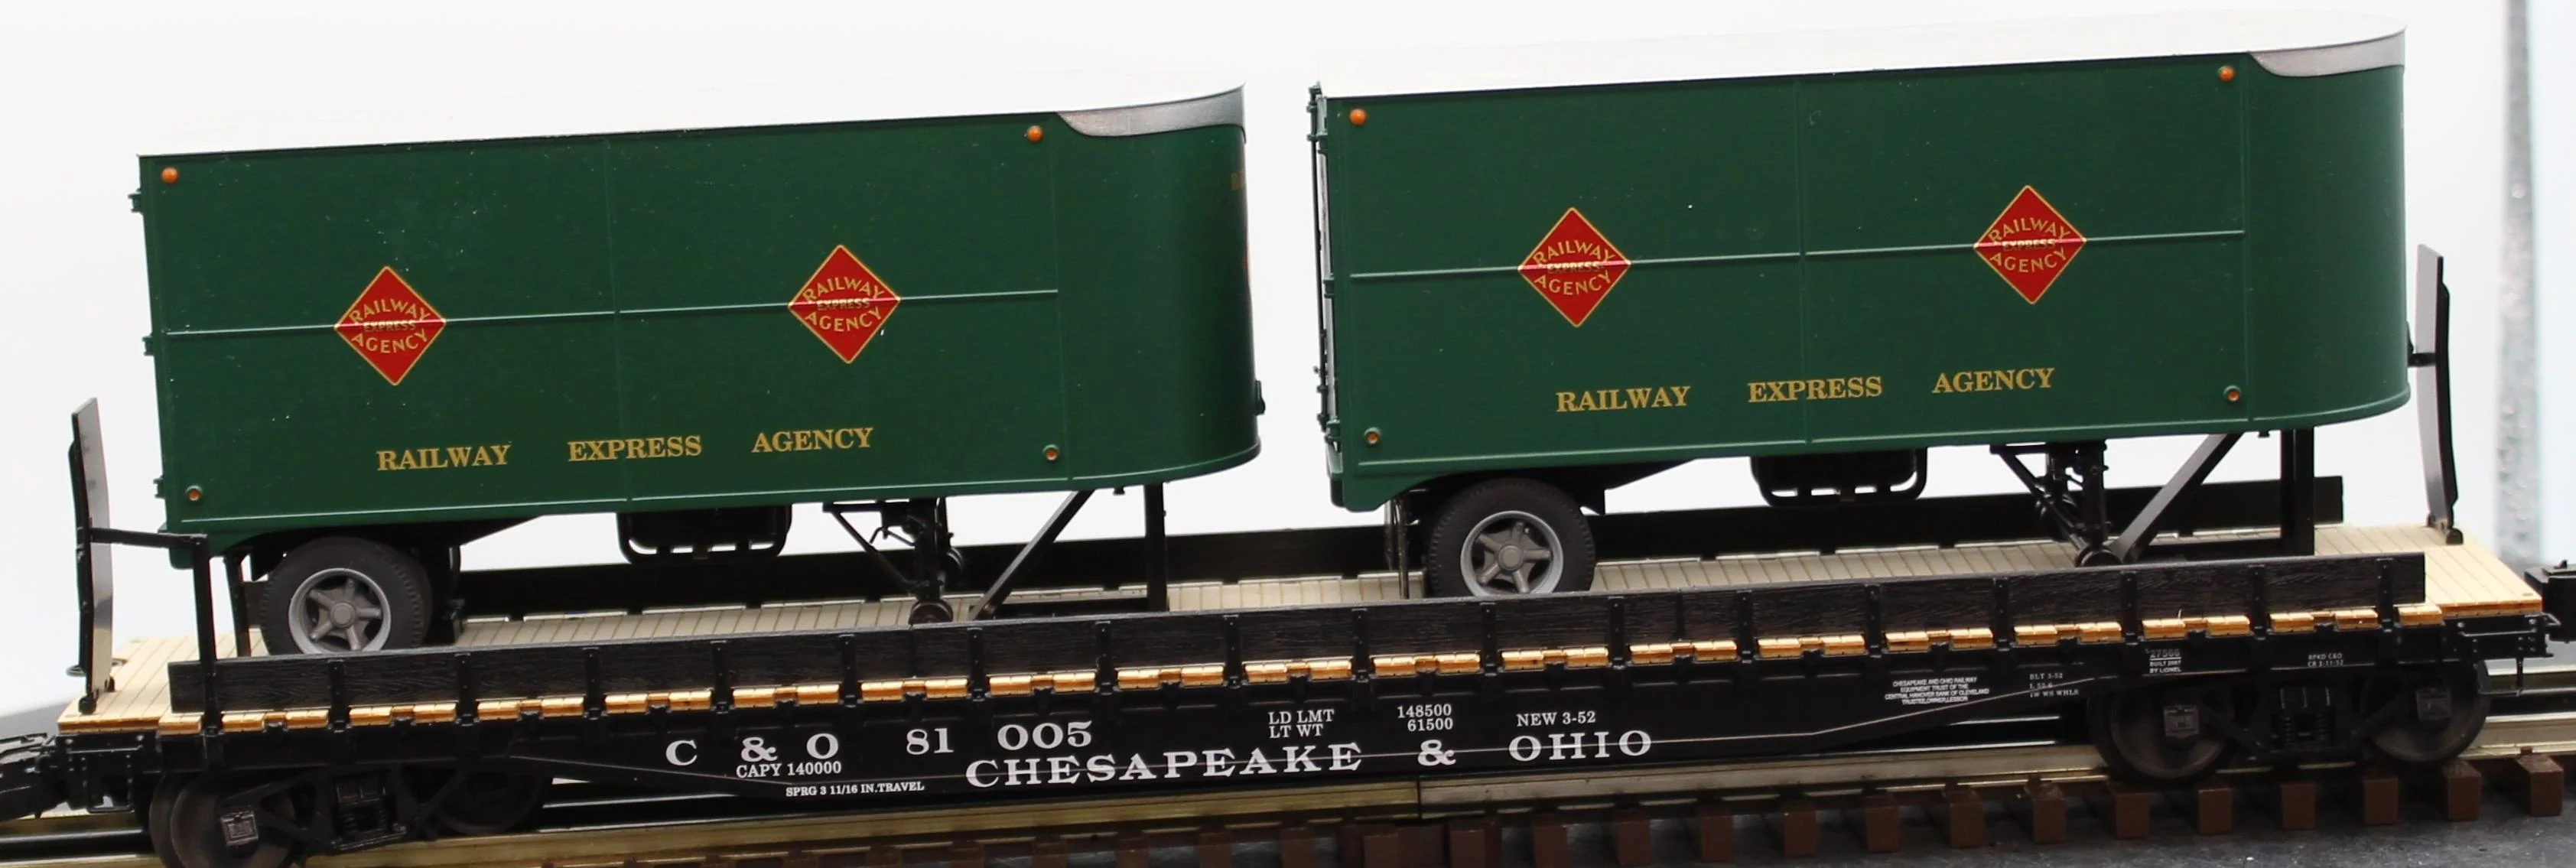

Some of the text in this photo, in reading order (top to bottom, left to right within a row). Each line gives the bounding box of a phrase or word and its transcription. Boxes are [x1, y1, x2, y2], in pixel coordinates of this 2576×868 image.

[1988, 217, 2071, 245] RAILWAY
[1532, 239, 1616, 267] RAILWAY
[1989, 246, 2067, 273] AGENCY
[802, 276, 885, 303] RAILWAY
[1534, 269, 1611, 296] AGENCY
[348, 298, 431, 325] RAILWAY
[805, 305, 881, 332] AGENCY
[350, 328, 428, 353] AGENCY
[1556, 367, 2054, 413] RAILWAY EXPRESS AGENCY
[376, 427, 874, 471] RAILWAY EXPRESS AGENCY
[1268, 708, 1335, 725] LD LMT
[1397, 703, 1452, 719] 148500
[1407, 717, 1454, 732] 61500
[1516, 710, 1596, 727] NEW 3-52
[906, 727, 955, 755] 81
[1269, 723, 1324, 739] LT WT
[665, 733, 839, 766] C & O
[965, 730, 1652, 788] CHESAPEAKE & OHIO
[736, 761, 842, 779] CAPY 140000
[785, 786, 818, 797] SPRG
[820, 785, 828, 796] 3
[830, 784, 858, 796] 11/16
